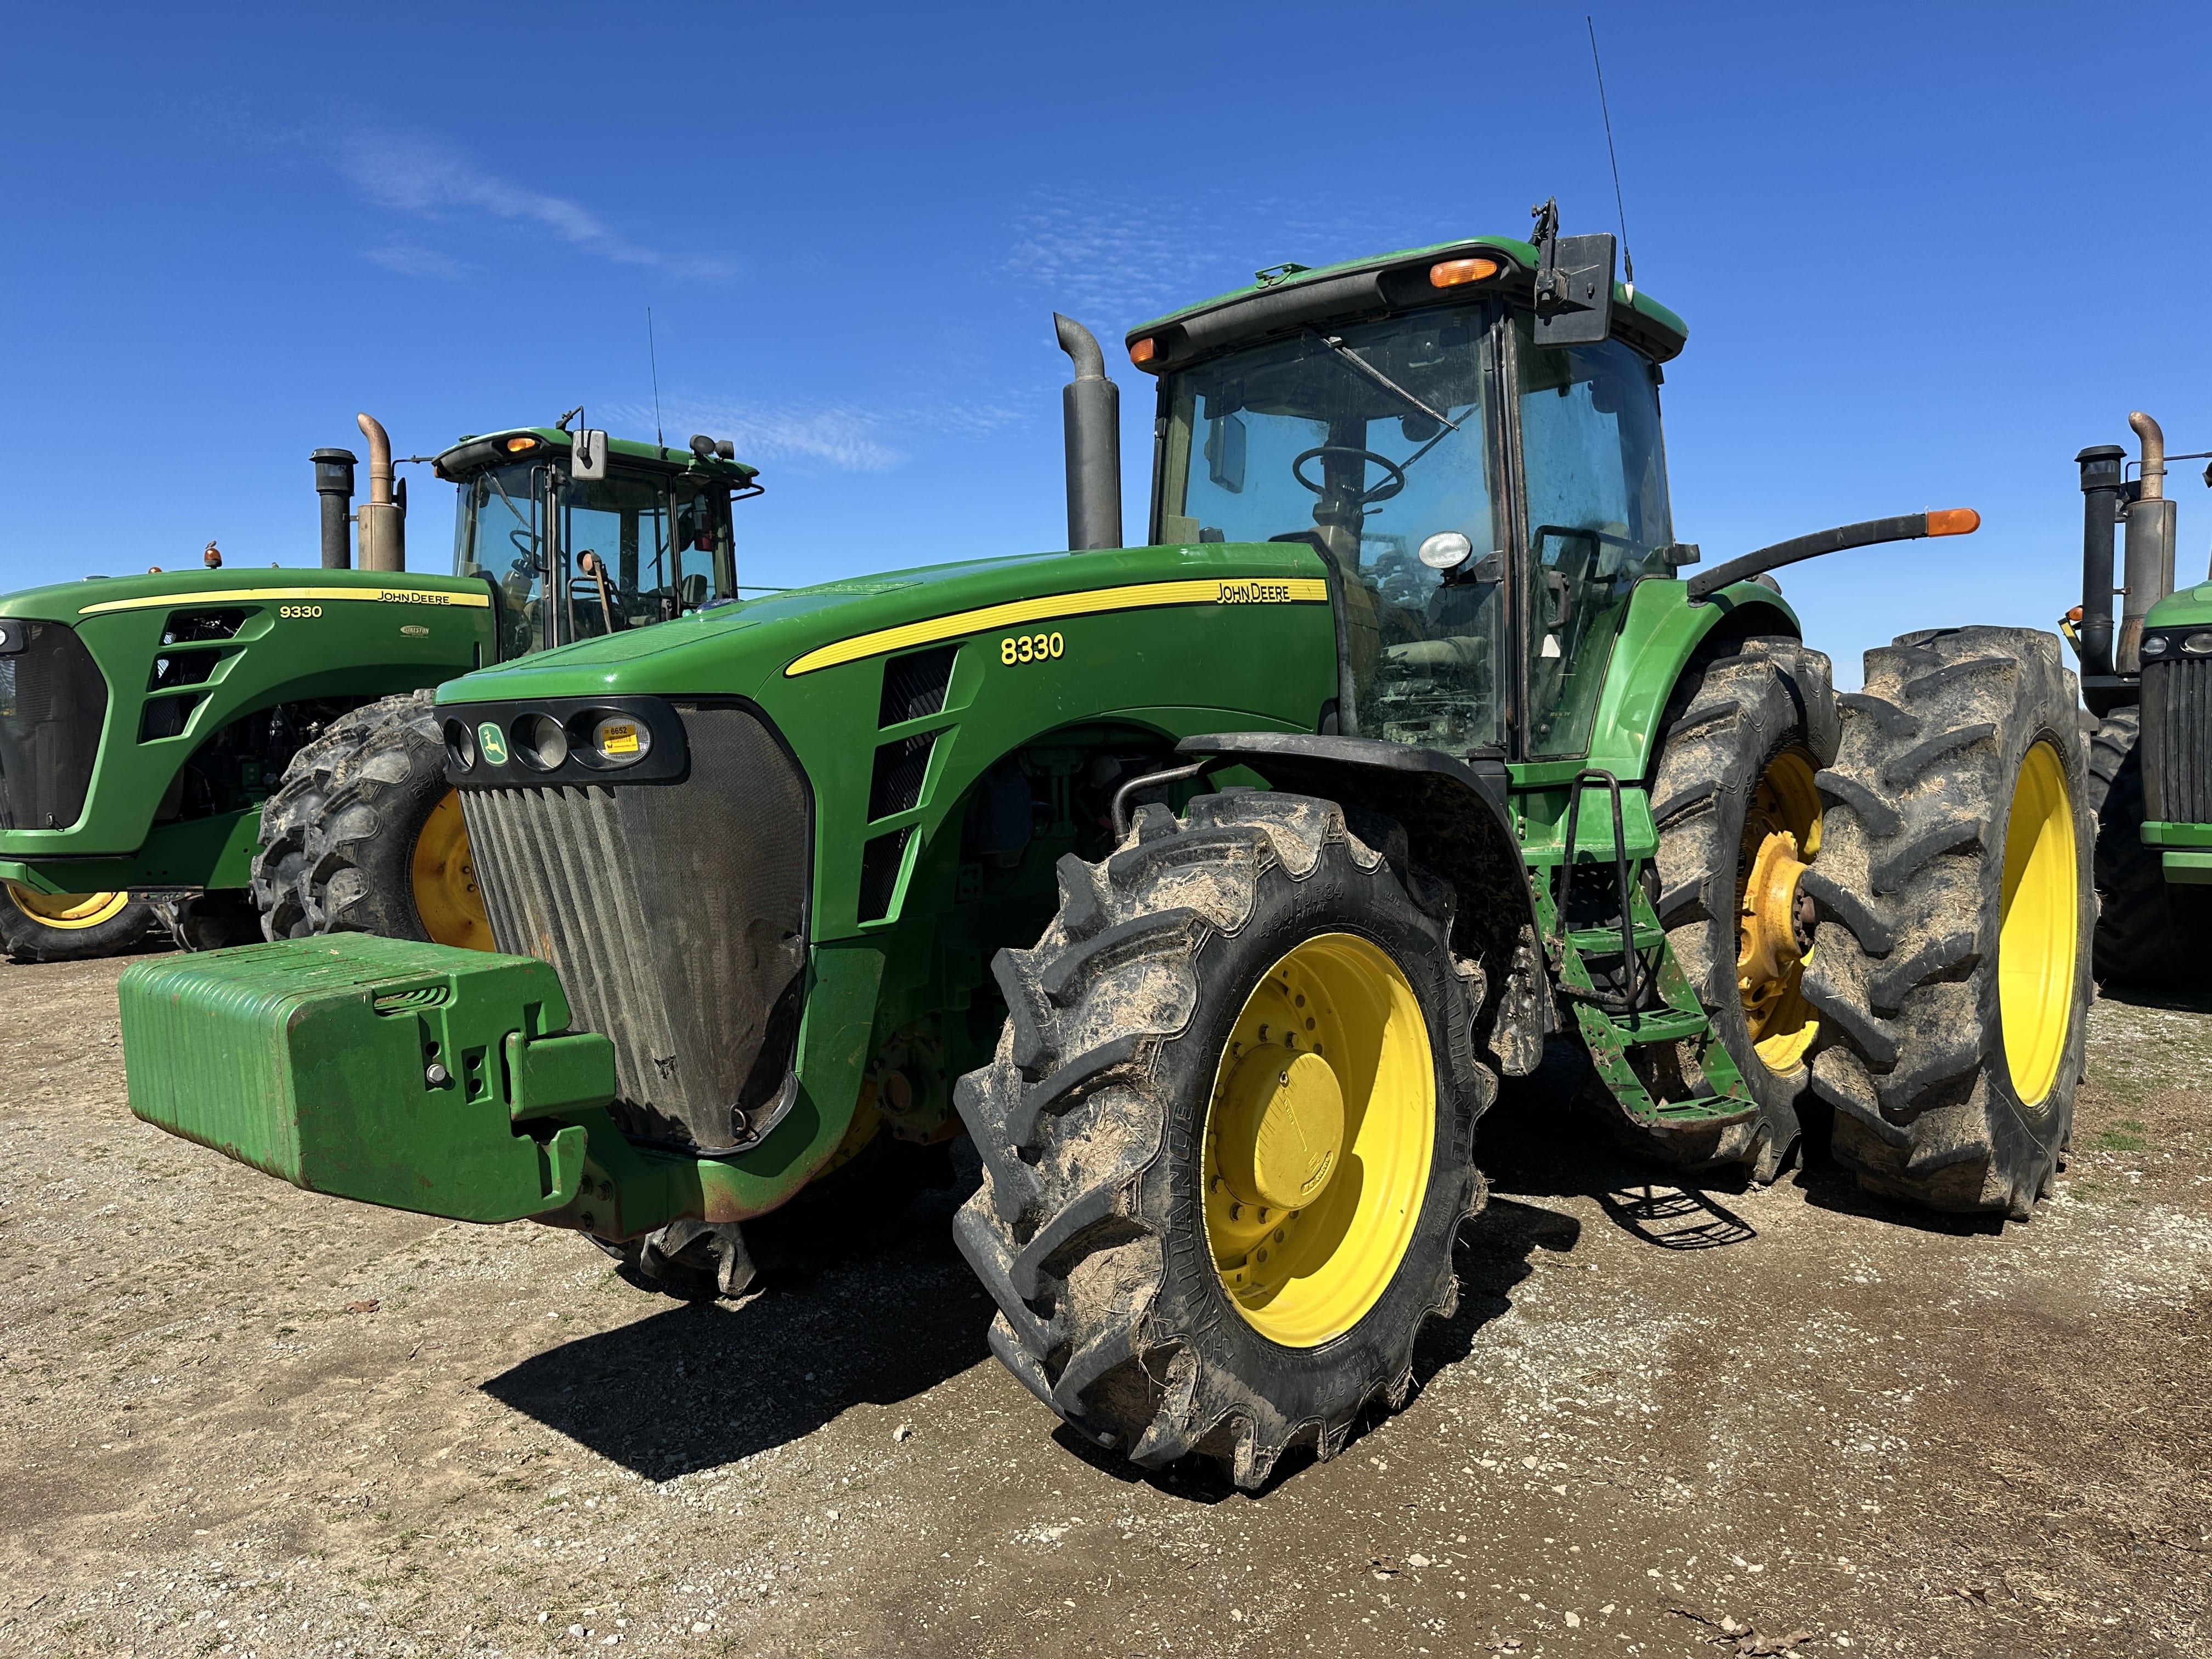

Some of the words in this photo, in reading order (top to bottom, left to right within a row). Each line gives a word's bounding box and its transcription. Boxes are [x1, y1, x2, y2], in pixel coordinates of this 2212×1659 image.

[377, 591, 409, 602] JOHN
[411, 592, 450, 604] DEERE
[1217, 583, 1250, 602] JOHN
[1251, 583, 1290, 601] DEERE
[280, 606, 323, 618] 9330
[1001, 632, 1064, 665] 8330
[1430, 976, 1471, 1162] ALLIANCE
[1169, 1104, 1220, 1337] ALLIANCE
[1314, 1376, 1346, 1407] 374
